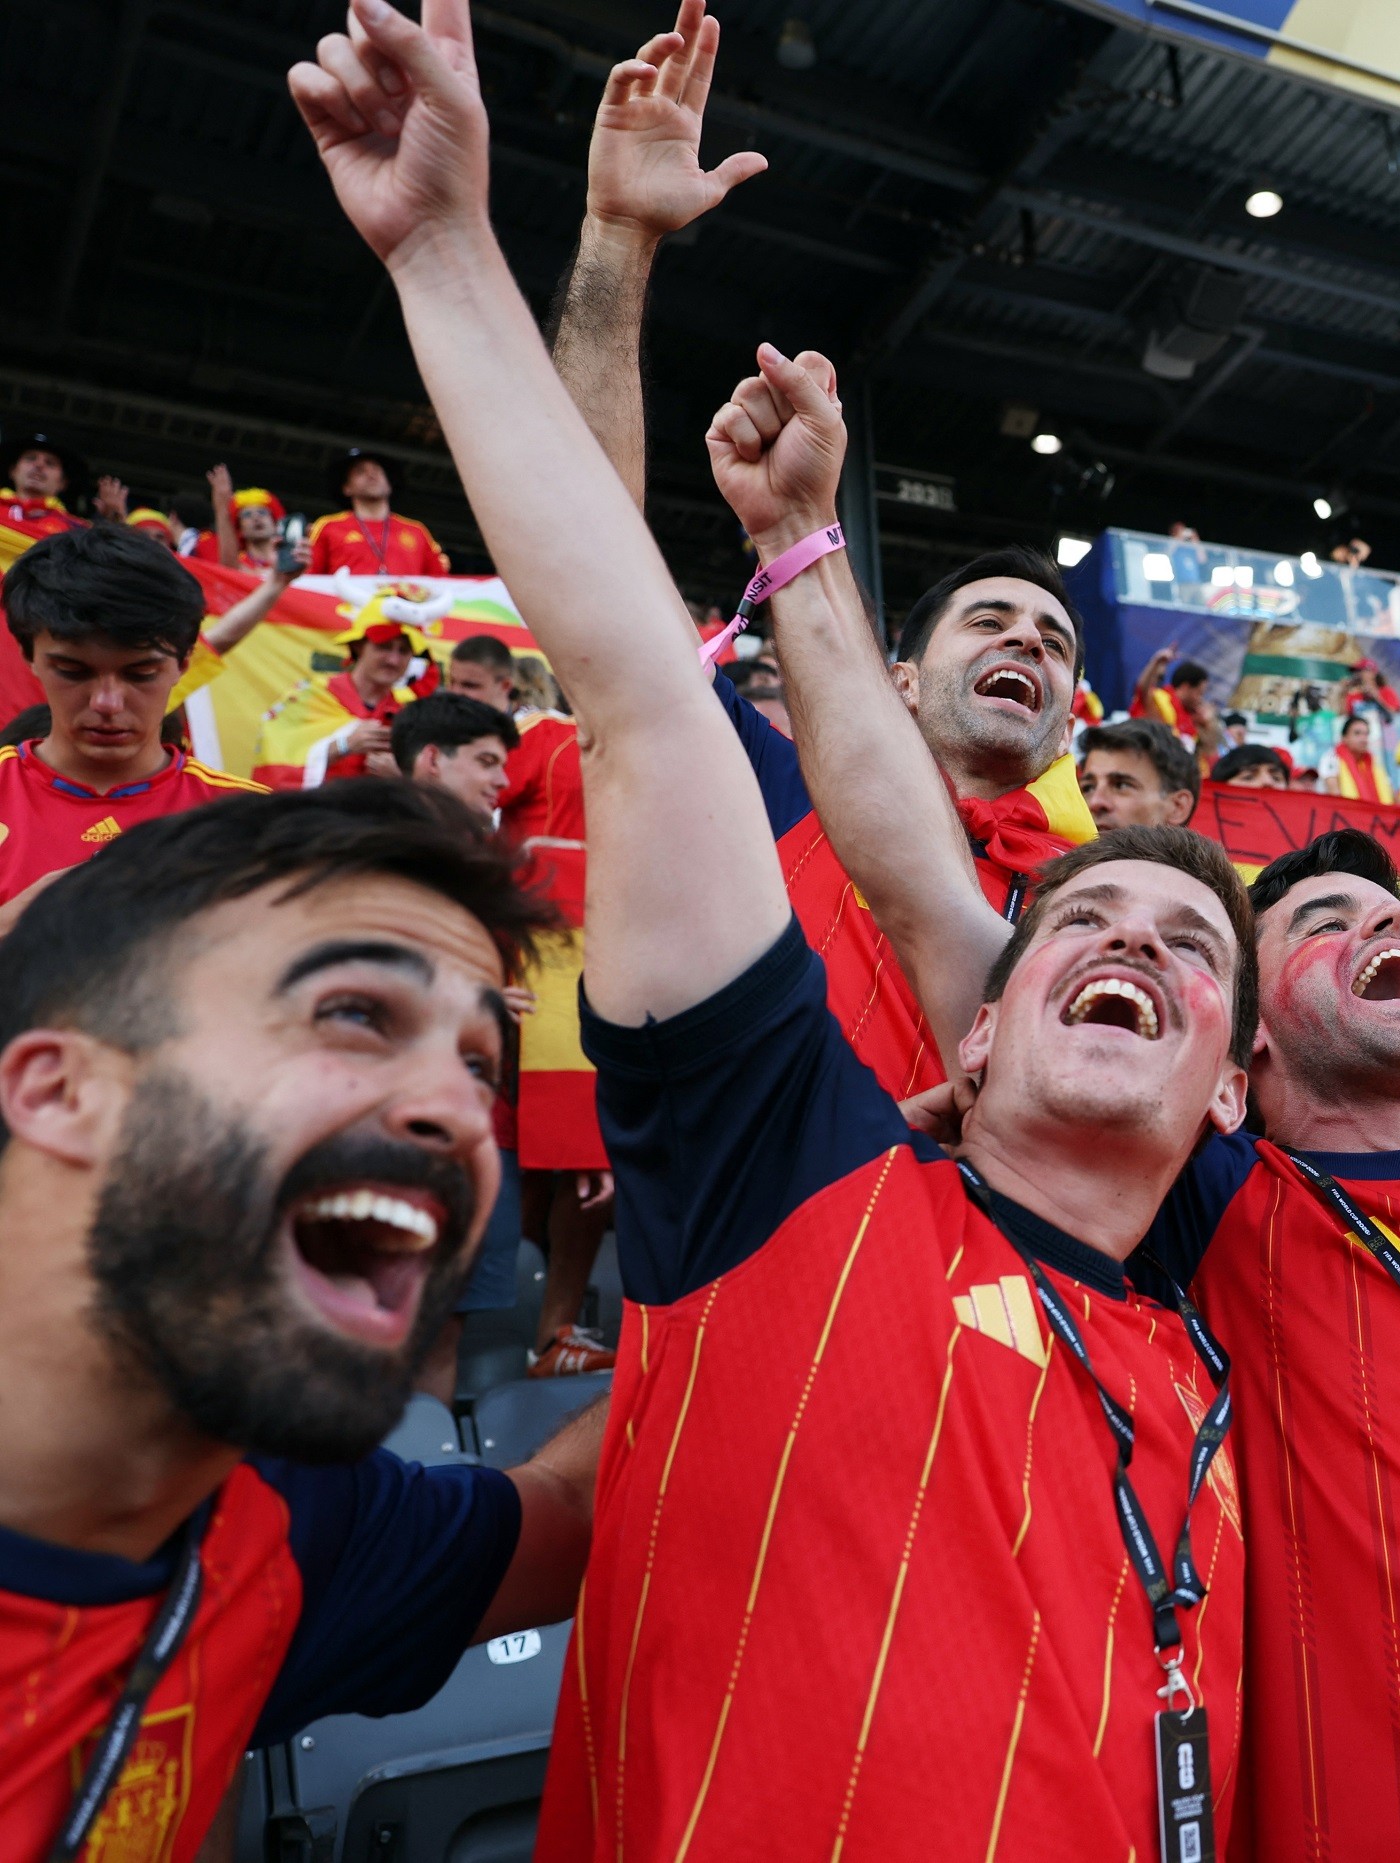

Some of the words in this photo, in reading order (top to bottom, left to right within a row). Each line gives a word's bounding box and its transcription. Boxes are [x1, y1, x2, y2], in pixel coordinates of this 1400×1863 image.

[1331, 1188, 1341, 1199] FIFA
[1338, 1197, 1352, 1214] WORLD
[1349, 1212, 1359, 1221] CUP
[1355, 1219, 1370, 1235] 2026
[1382, 1250, 1393, 1262] FIFA
[1191, 1318, 1200, 1332] FIFA
[1196, 1330, 1210, 1348] WORLD
[1205, 1346, 1216, 1356] CUP
[1211, 1354, 1224, 1371] 2026
[500, 1635, 526, 1656] 17
